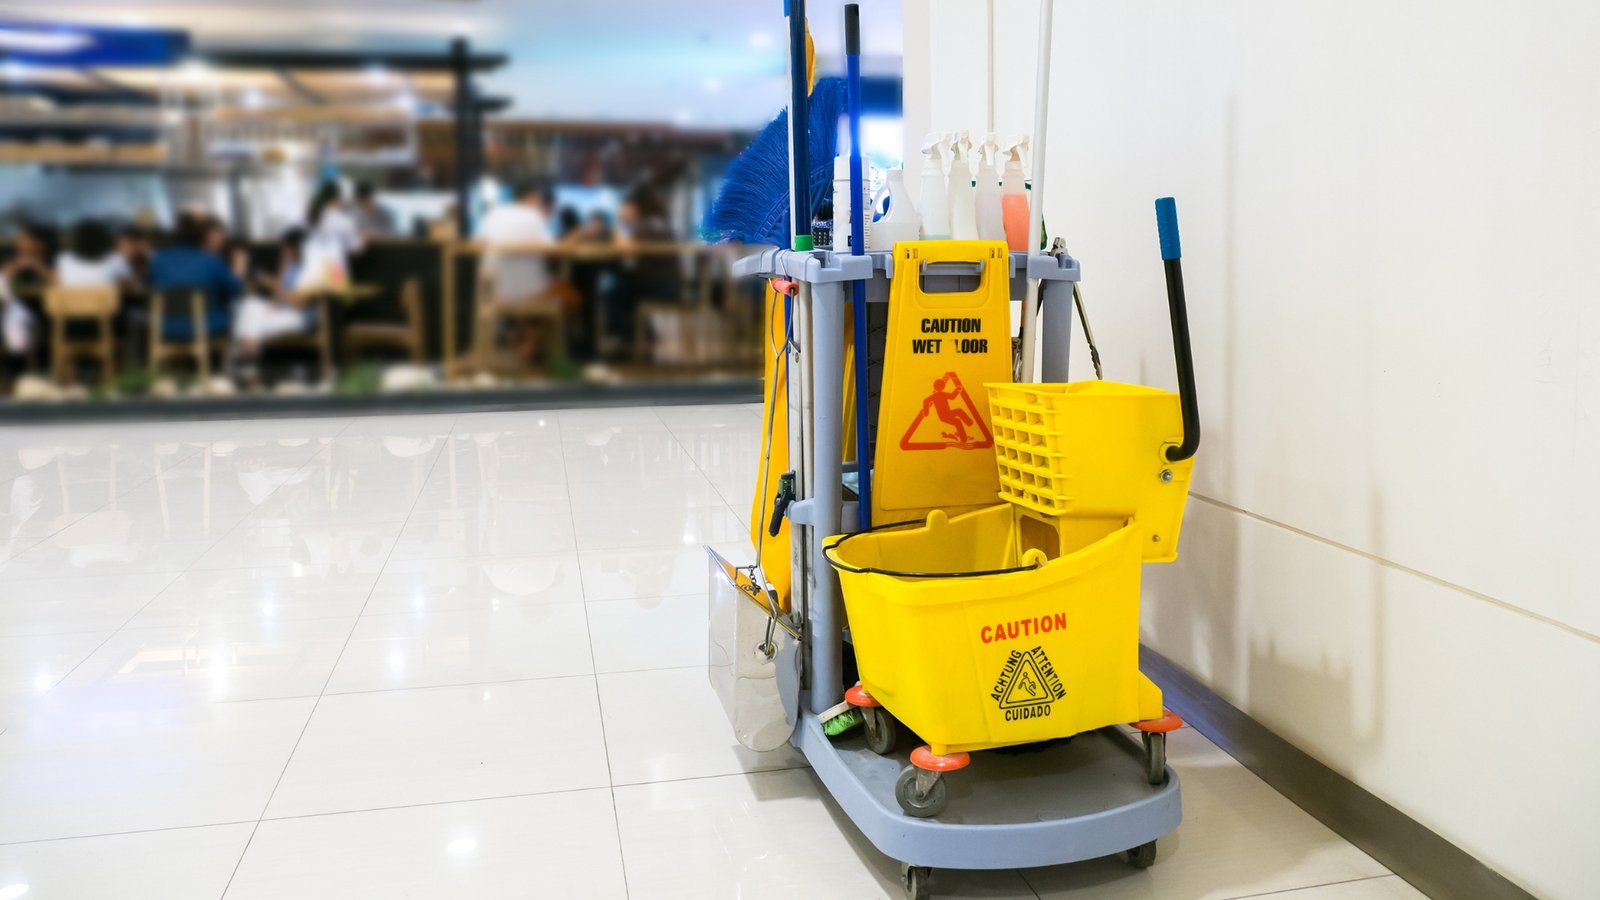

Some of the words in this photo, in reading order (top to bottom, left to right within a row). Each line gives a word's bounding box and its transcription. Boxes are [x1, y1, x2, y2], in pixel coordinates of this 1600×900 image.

[921, 318, 981, 333] CAUTION
[912, 339, 942, 353] WET
[954, 339, 988, 353] LOOR
[981, 612, 1067, 644] CAUTION
[990, 649, 1022, 701] ACHTUNG
[1031, 645, 1067, 700] ATTENTION
[1005, 704, 1051, 721] CUIDADO
